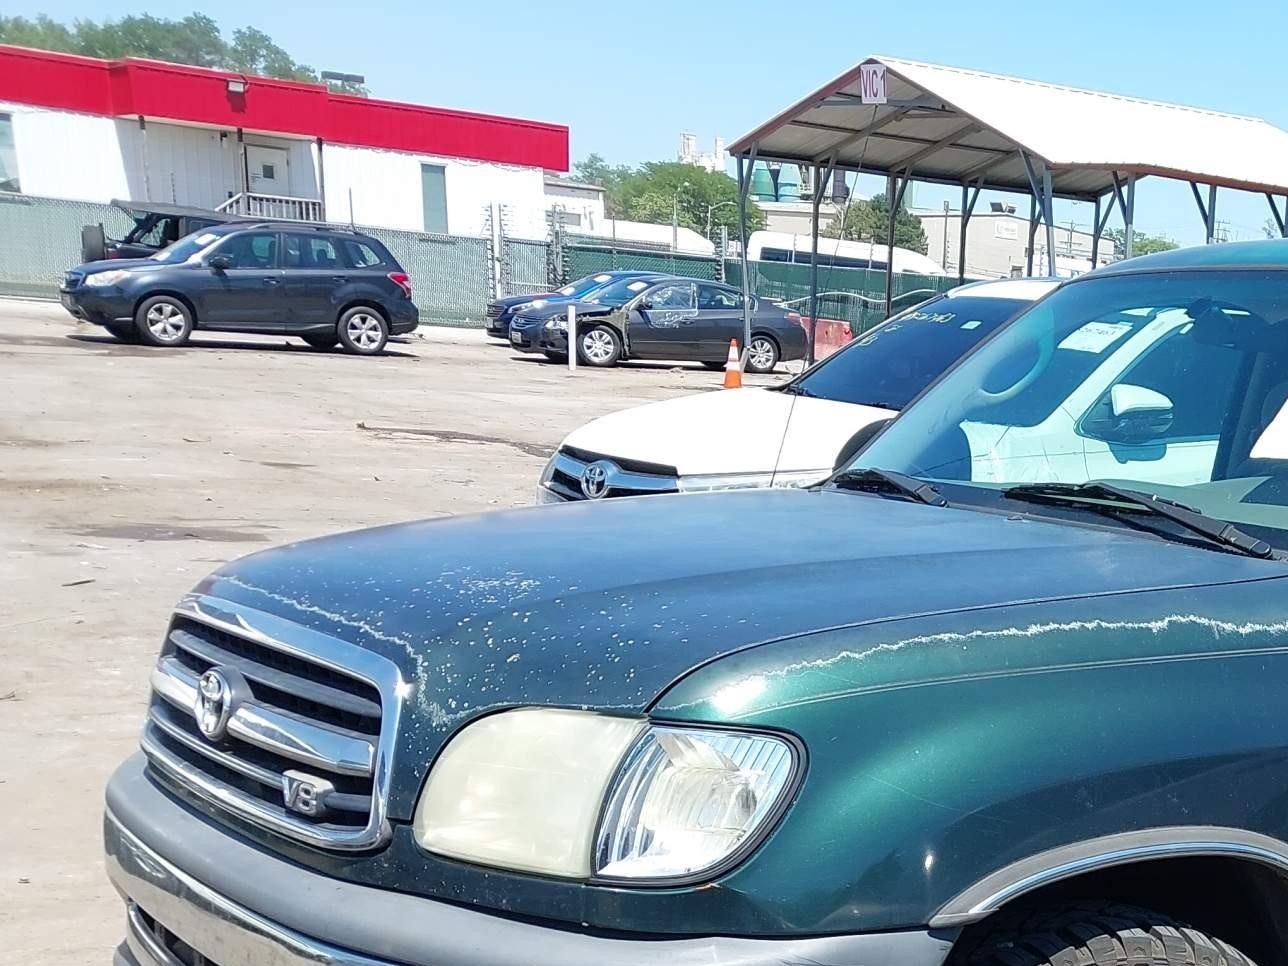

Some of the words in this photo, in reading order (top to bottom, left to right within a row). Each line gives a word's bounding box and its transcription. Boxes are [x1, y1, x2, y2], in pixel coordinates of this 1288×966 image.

[861, 69, 878, 98] VIC
[881, 69, 886, 97] 1
[282, 775, 318, 817] V8
